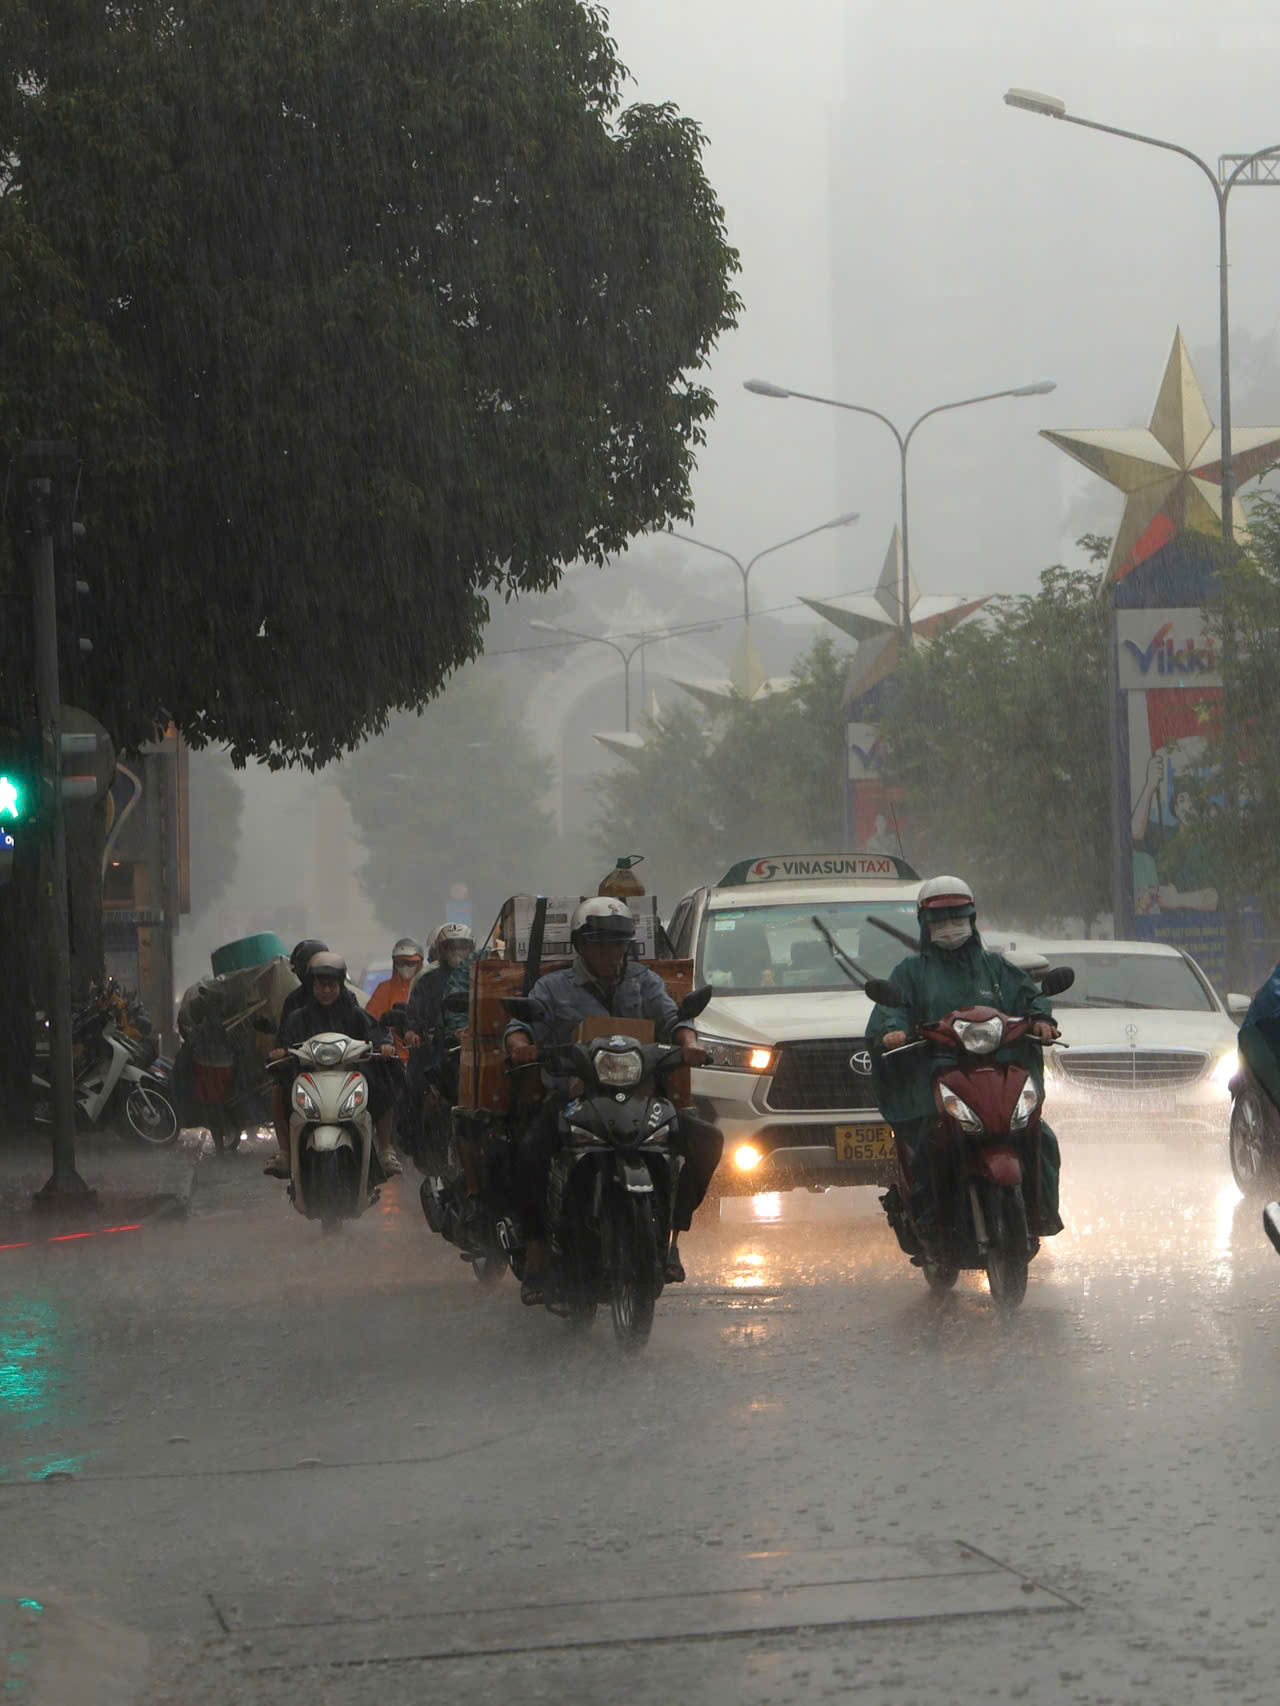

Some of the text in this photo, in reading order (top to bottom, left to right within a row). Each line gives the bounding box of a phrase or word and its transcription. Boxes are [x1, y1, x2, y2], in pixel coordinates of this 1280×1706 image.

[783, 859, 891, 875] VINASUN TAXI
[647, 1102, 662, 1128] 110
[855, 1127, 885, 1143] 50E
